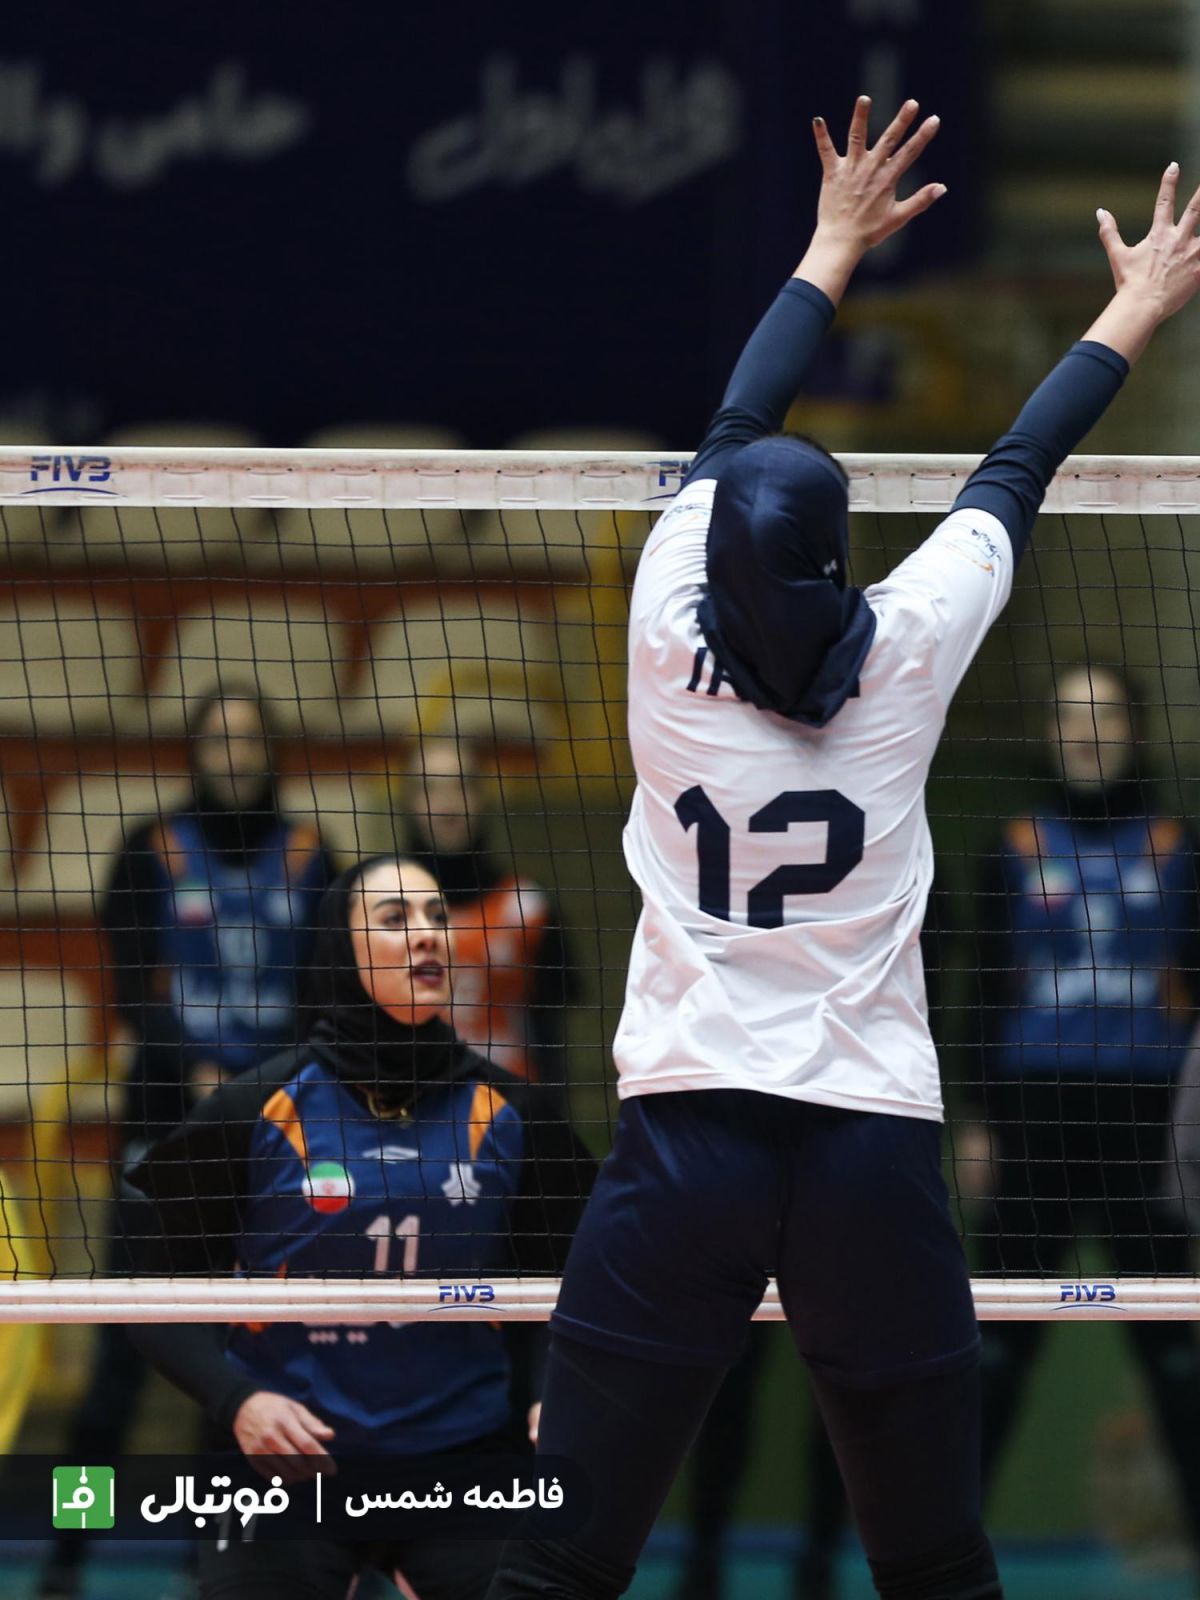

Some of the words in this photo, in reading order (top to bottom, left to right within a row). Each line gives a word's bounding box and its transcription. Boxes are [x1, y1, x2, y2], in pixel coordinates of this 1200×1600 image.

[30, 455, 111, 482] FIVB
[673, 784, 866, 930] 12
[364, 1214, 421, 1277] 11
[438, 1284, 496, 1303] FIVB
[1059, 1284, 1116, 1302] FIVB
